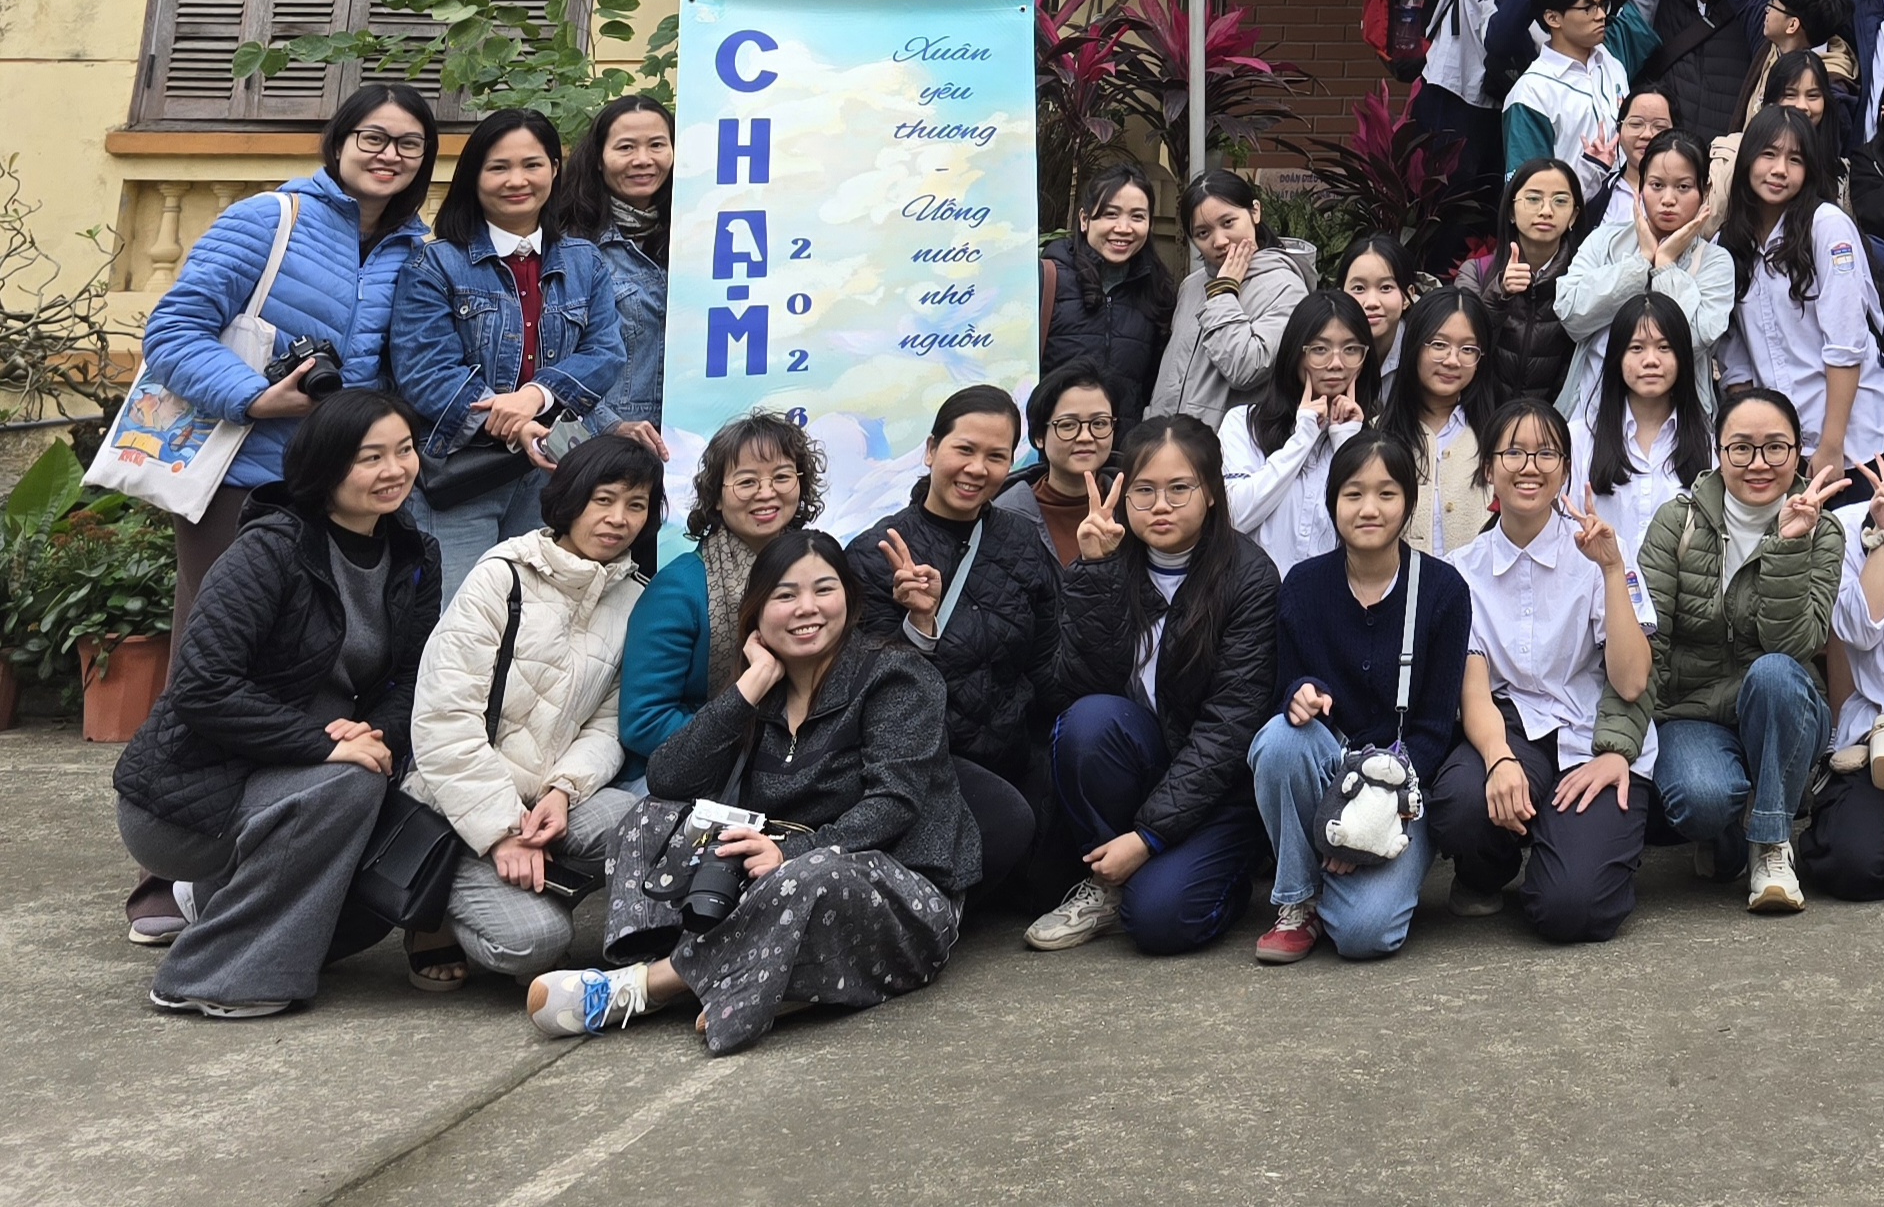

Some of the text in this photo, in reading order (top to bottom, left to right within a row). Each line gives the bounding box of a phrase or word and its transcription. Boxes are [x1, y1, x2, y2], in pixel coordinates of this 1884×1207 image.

[892, 36, 992, 63] Xuân
[919, 82, 974, 108] yêu
[893, 119, 997, 148] thương
[901, 193, 991, 228] Uống
[911, 241, 982, 264] nước
[918, 283, 976, 306] nhớ
[898, 322, 993, 351] nguồn
